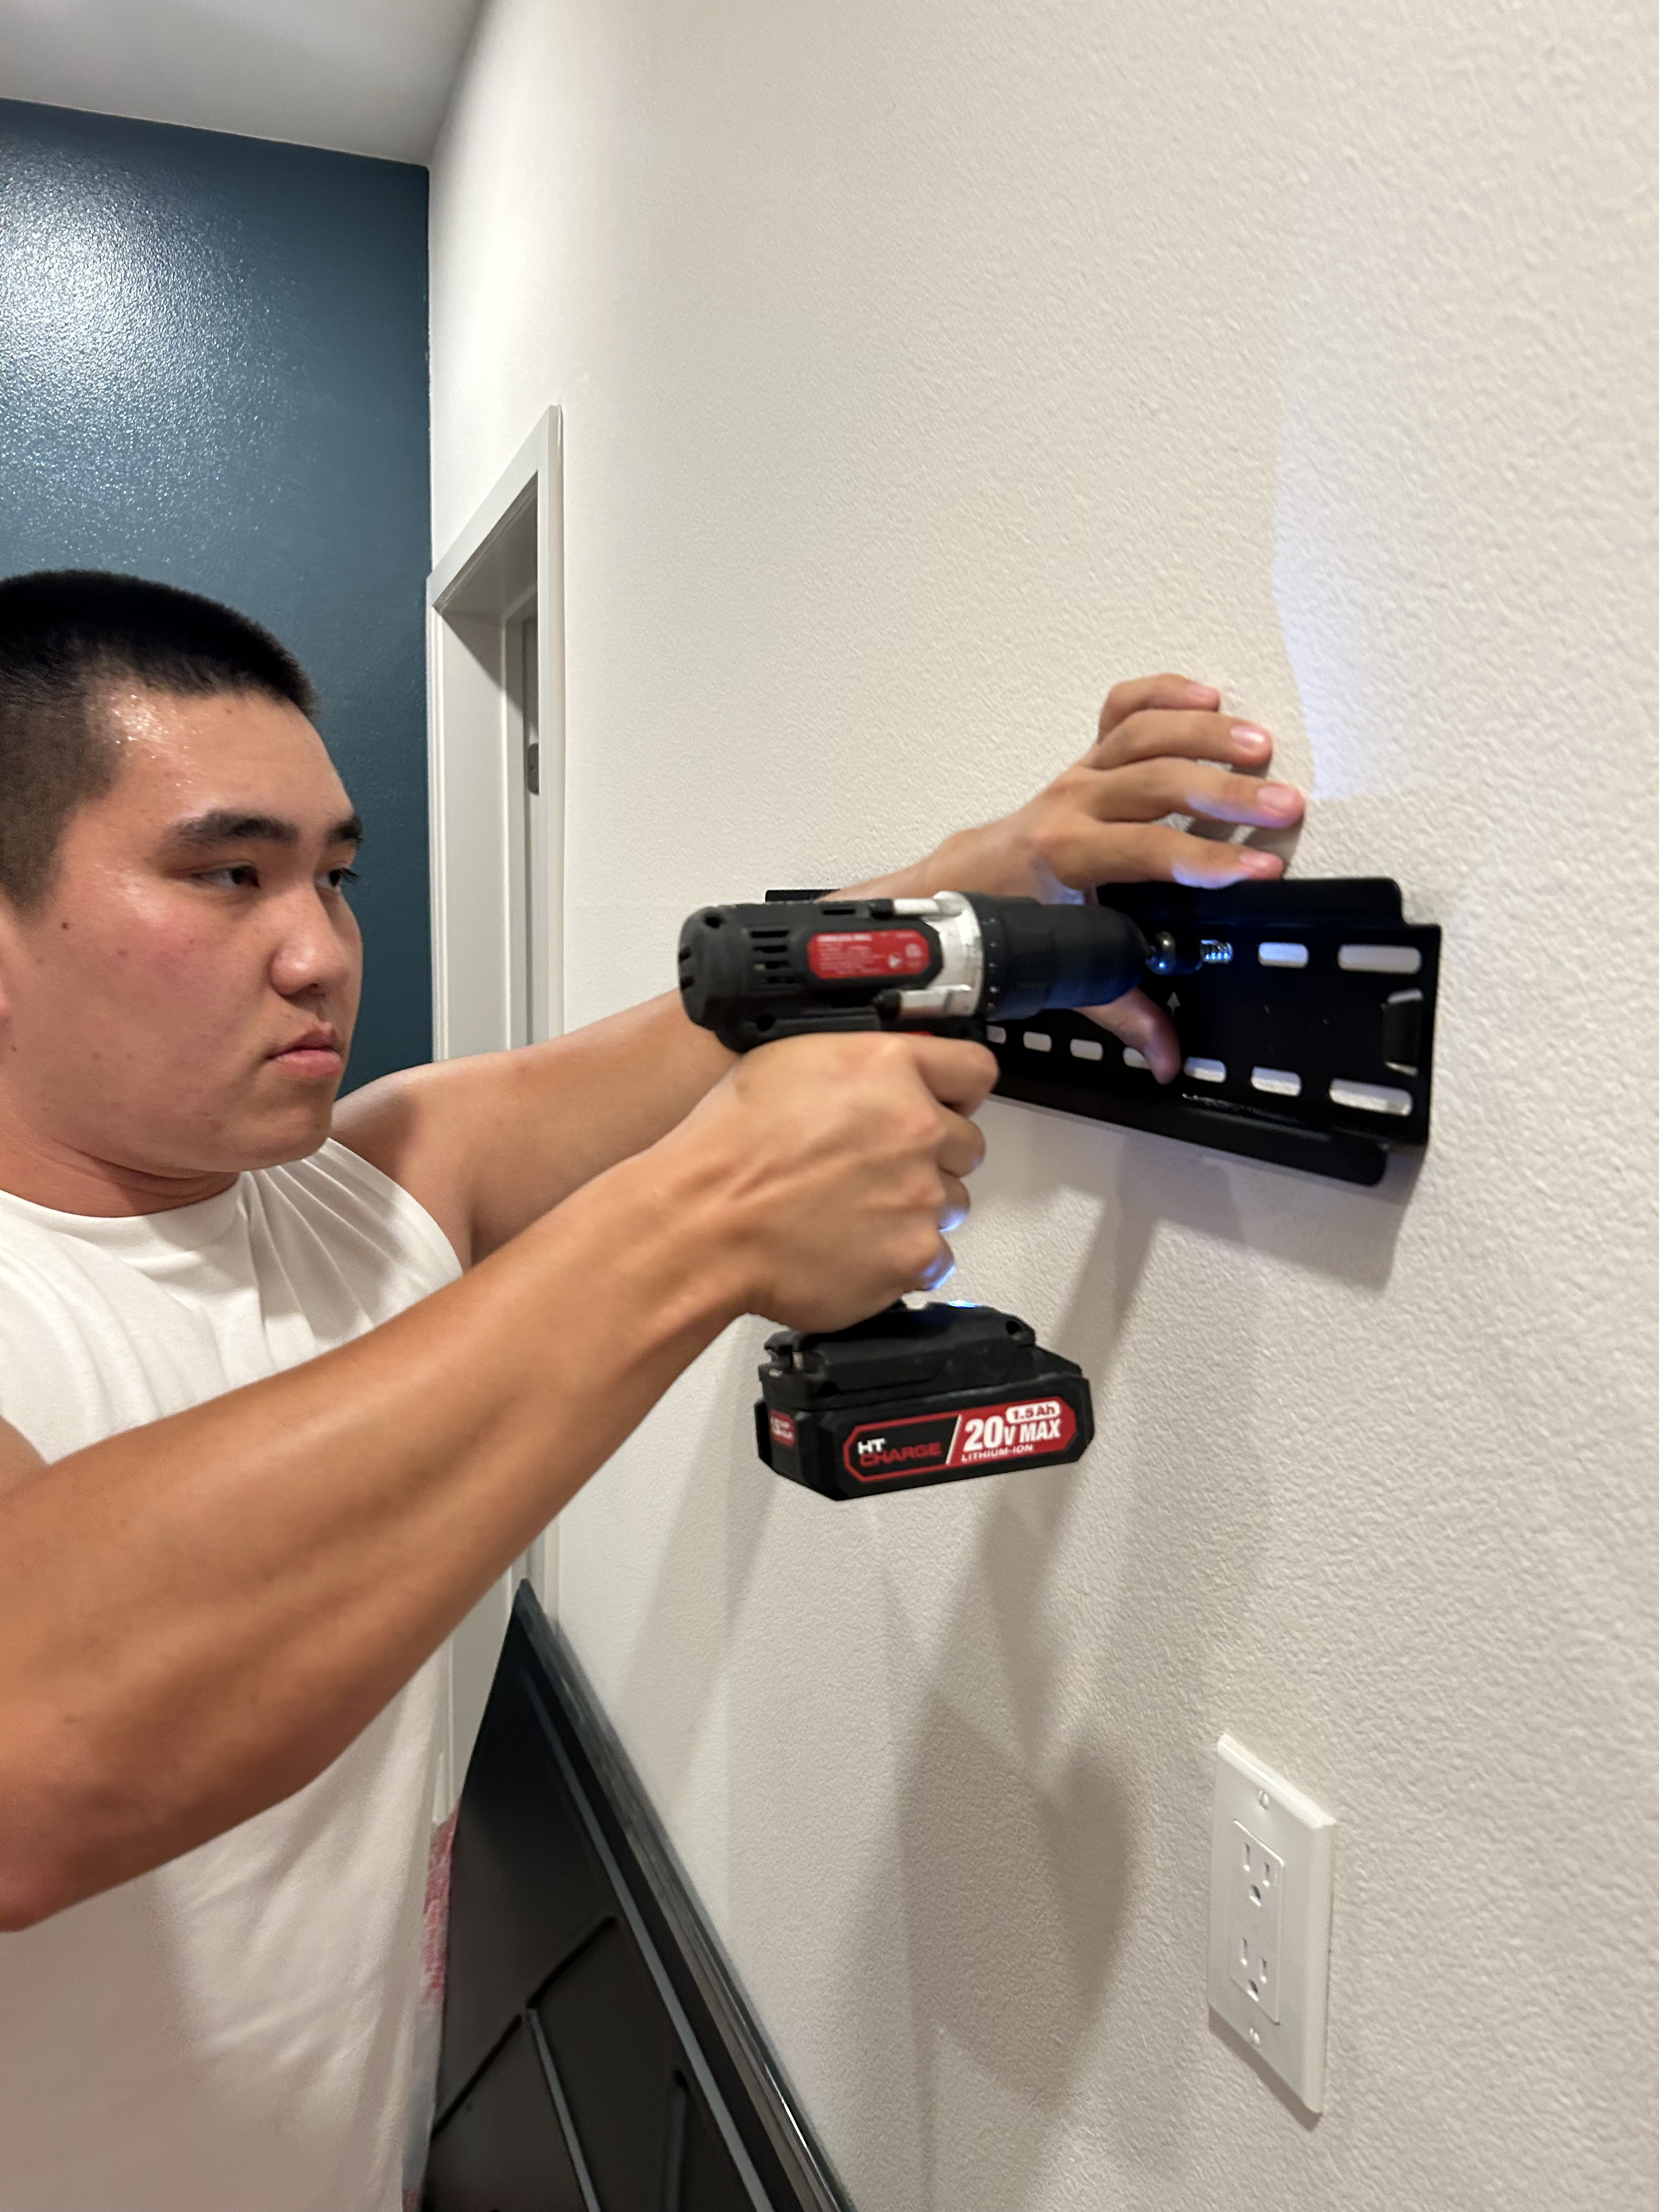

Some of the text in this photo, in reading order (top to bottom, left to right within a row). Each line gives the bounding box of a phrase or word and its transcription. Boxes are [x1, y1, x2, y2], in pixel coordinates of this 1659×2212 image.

[1019, 1419, 1060, 1443] MAX
[857, 1437, 887, 1455] HT
[860, 1442, 942, 1468] CHARGE
[961, 1443, 1033, 1463] LITHIUM-ION
